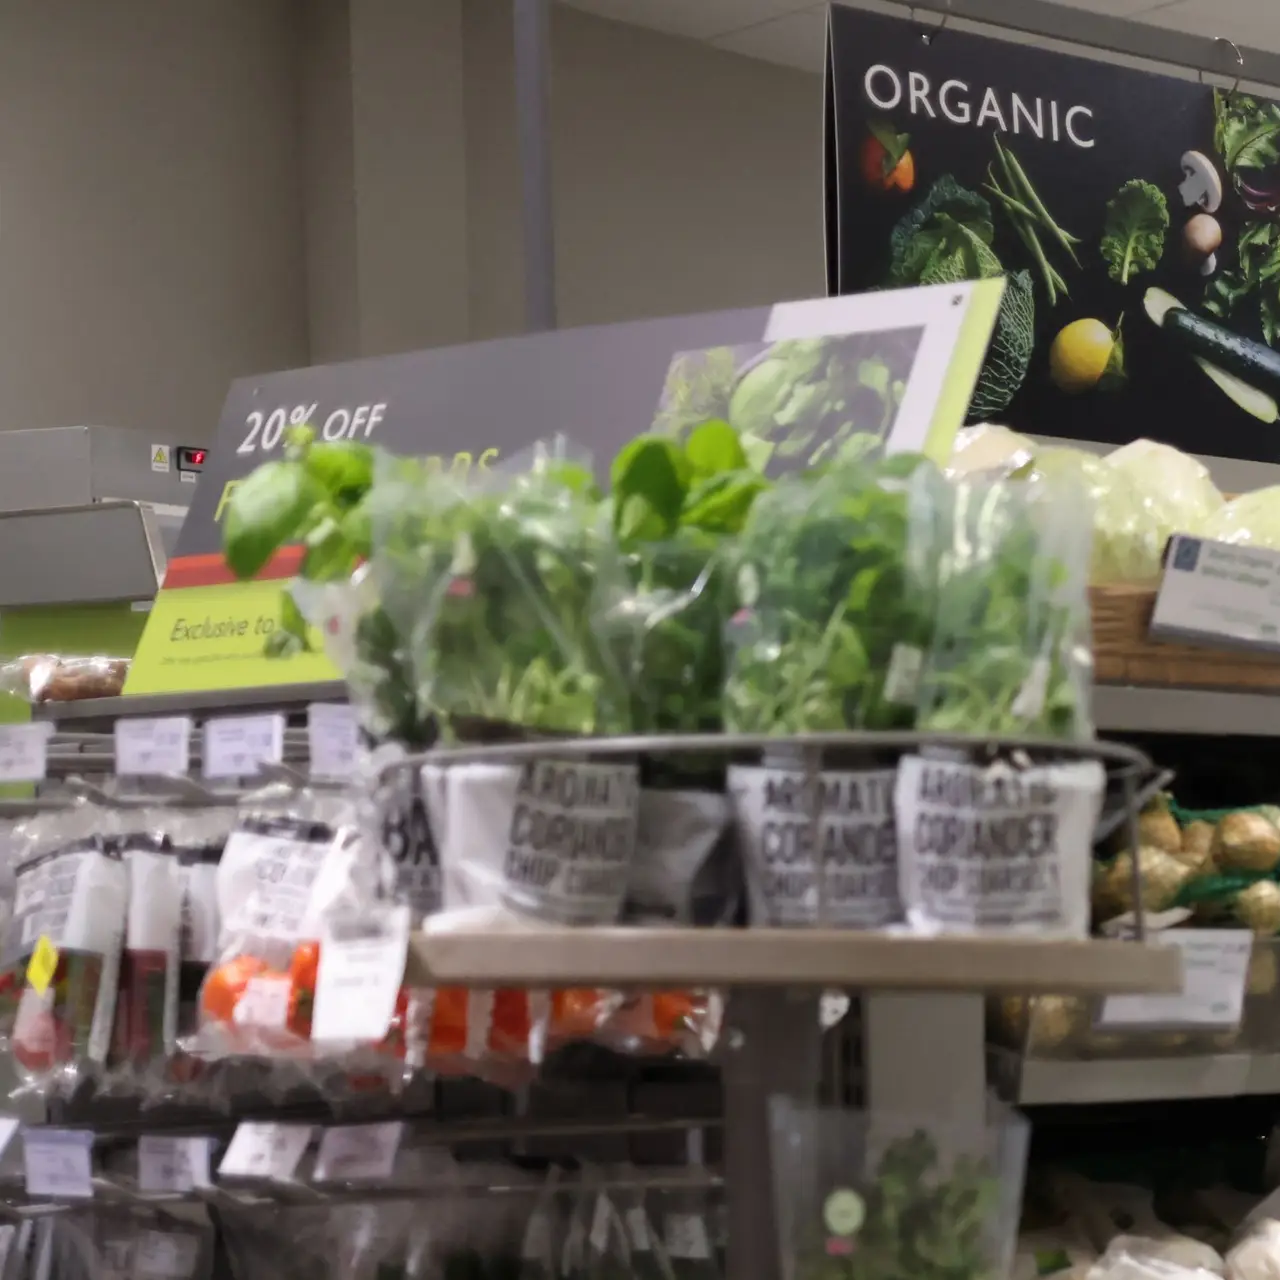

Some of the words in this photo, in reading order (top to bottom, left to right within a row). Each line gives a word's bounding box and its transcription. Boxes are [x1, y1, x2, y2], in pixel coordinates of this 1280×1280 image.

[864, 63, 1096, 148] ORGANIC
[322, 403, 388, 442] OFF
[170, 617, 249, 643] Exclusive
[253, 615, 275, 635] to
